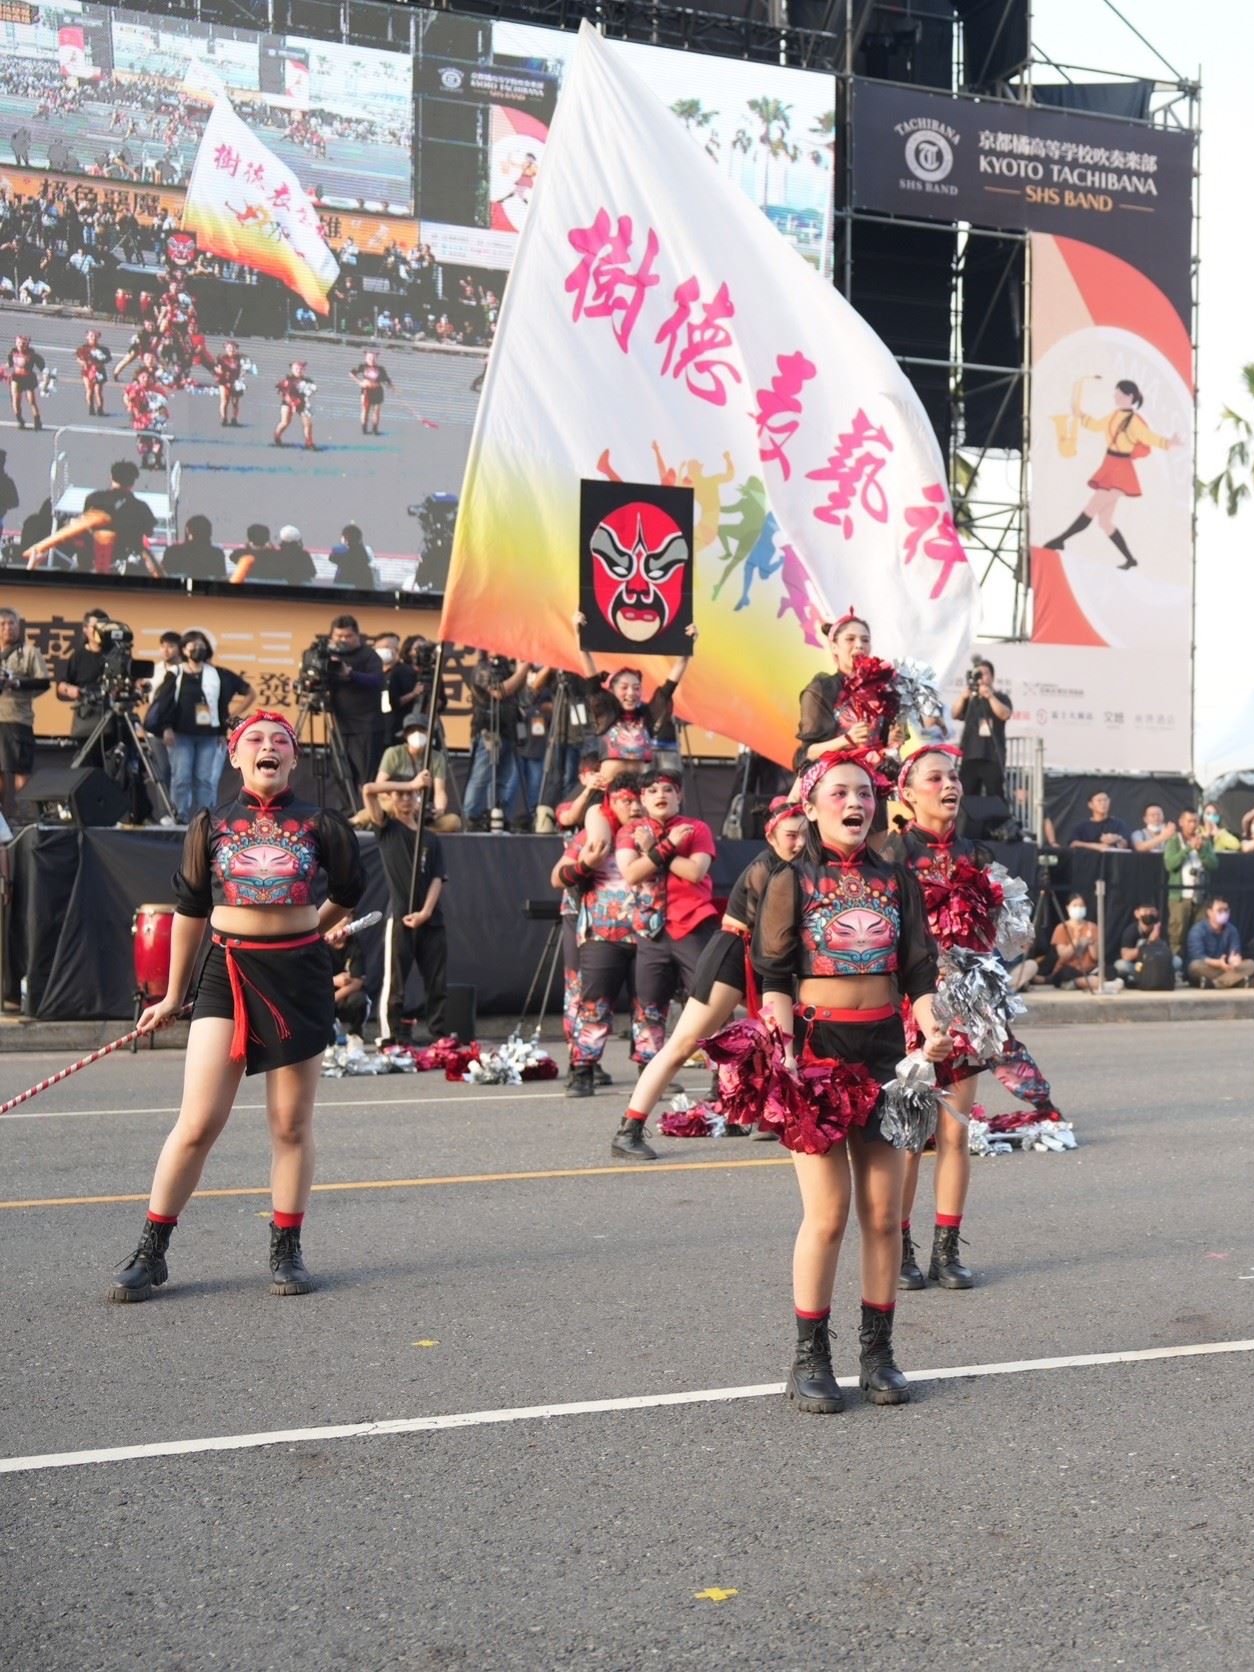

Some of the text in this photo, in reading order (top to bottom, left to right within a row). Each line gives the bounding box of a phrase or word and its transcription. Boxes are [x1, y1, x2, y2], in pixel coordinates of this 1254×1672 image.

[894, 117, 960, 145] TACHIBANA
[899, 178, 958, 195] SHS BAND
[979, 154, 1158, 196] KYOTO TACHIBANA
[1025, 185, 1114, 212] SHS BAND
